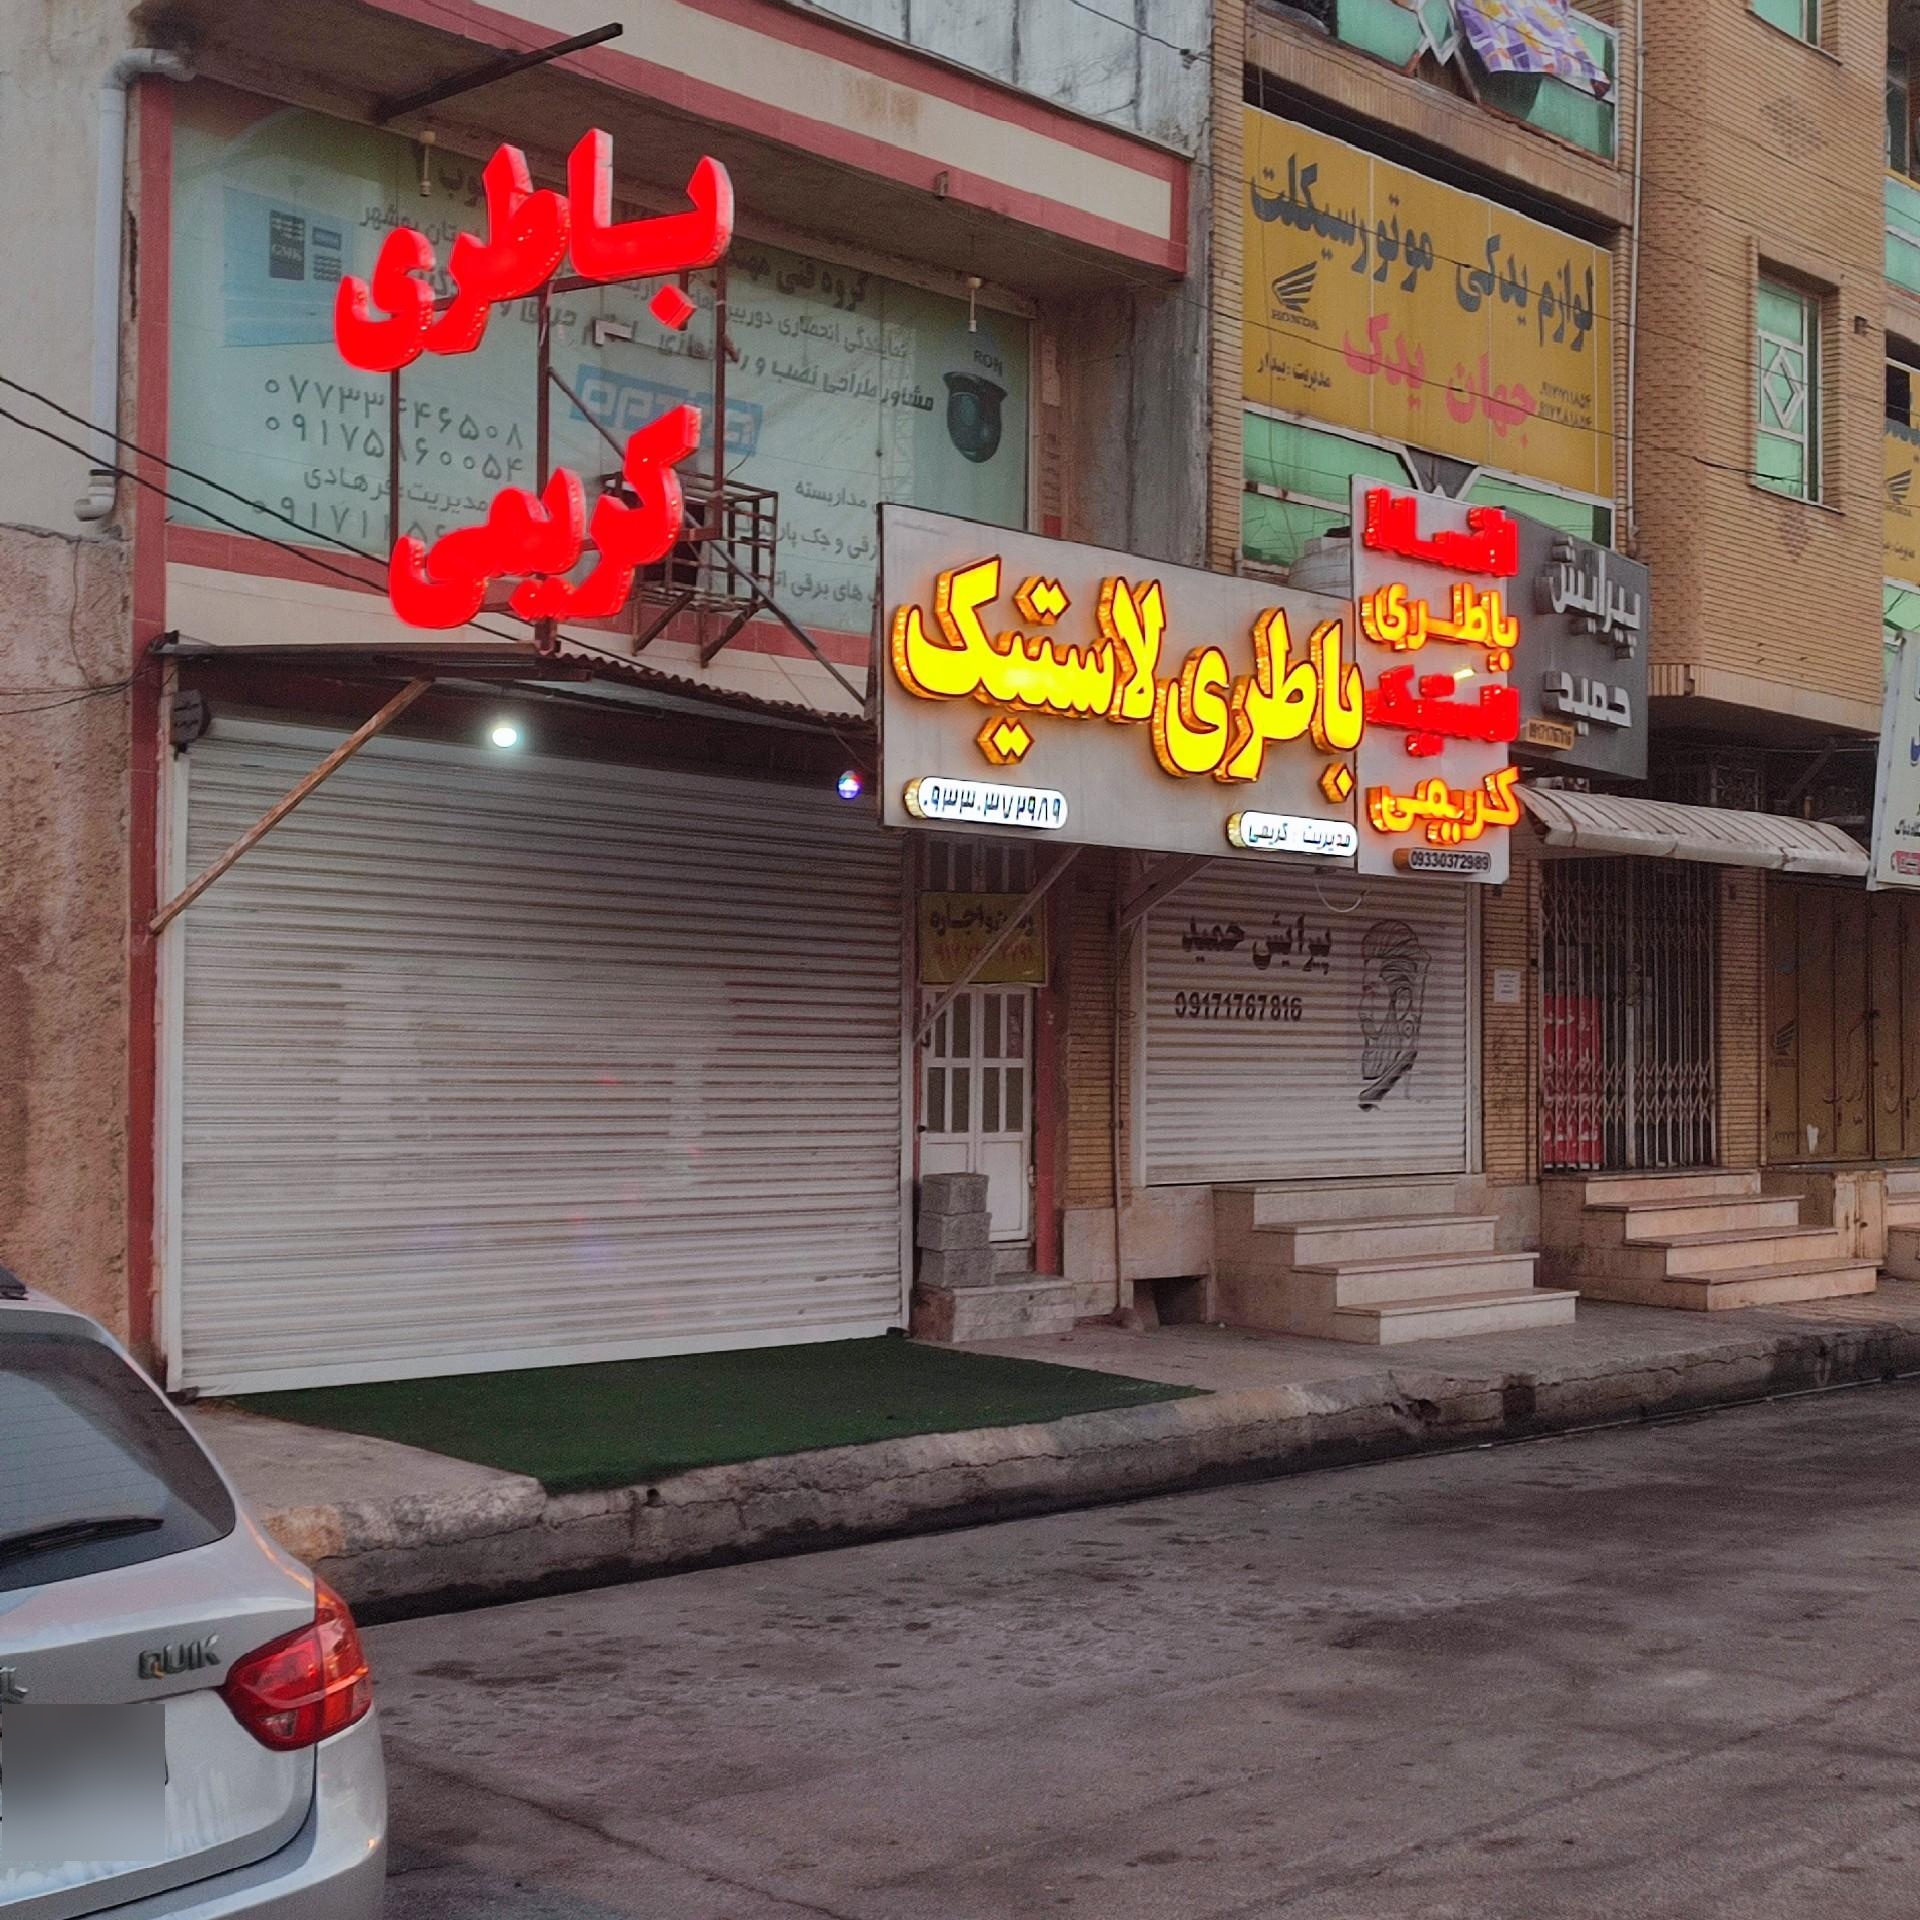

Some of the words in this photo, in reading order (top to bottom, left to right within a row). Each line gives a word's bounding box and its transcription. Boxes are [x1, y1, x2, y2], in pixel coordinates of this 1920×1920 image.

[335, 128, 734, 371] باطری
[1455, 233, 1528, 326] یدکی
[1538, 259, 1594, 353] لوازم
[771, 360, 818, 385] نصب
[822, 372, 878, 398] طراحی
[880, 384, 935, 412] مشاور
[1343, 312, 1426, 411] یدک
[1445, 351, 1537, 449] جهان
[390, 404, 702, 630] کریمی
[795, 480, 867, 509] مداربسته
[834, 537, 844, 555] و
[891, 554, 1166, 767] لاستیک
[1360, 582, 1520, 673] باطری
[1151, 605, 1366, 804] باطری
[1556, 670, 1633, 737] حمید
[1365, 766, 1521, 846] کریمی
[1181, 916, 1246, 963] حمید
[1175, 991, 1303, 1023] 09171767816
[138, 1634, 221, 1681] QUIK
